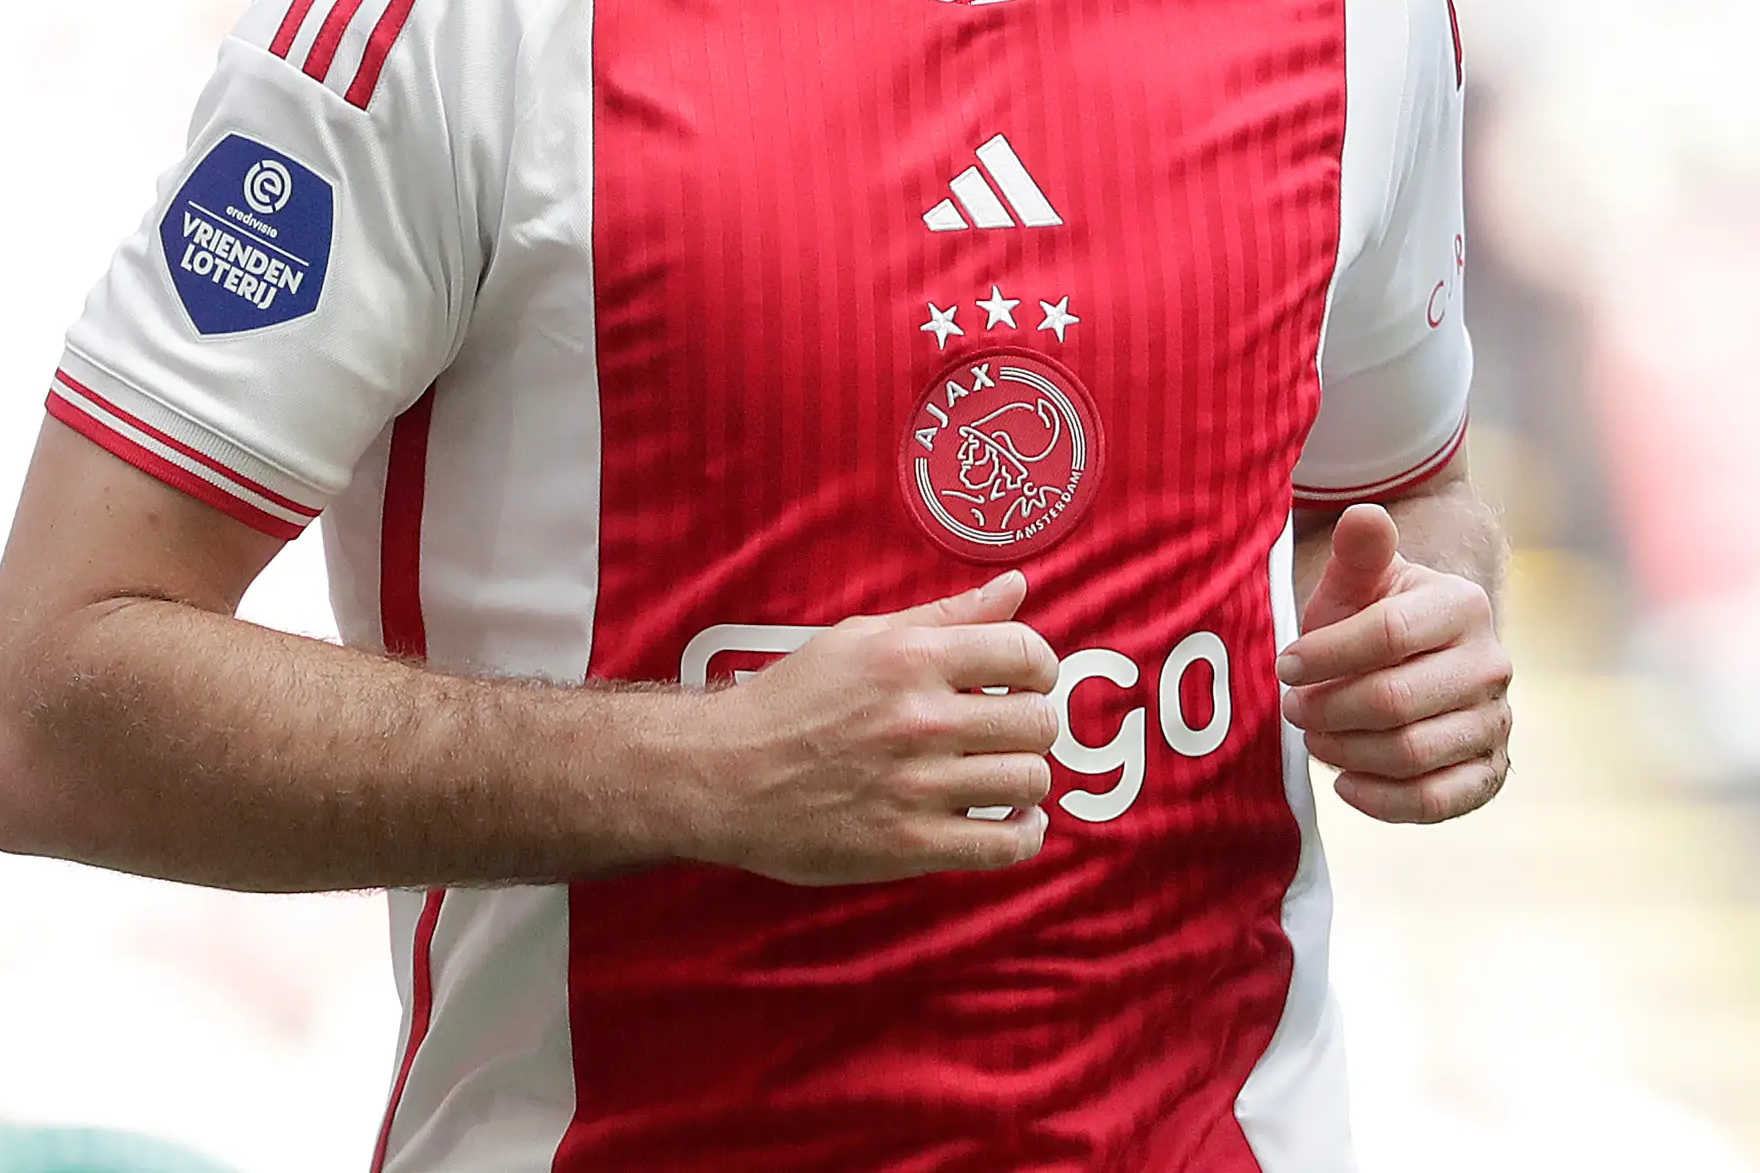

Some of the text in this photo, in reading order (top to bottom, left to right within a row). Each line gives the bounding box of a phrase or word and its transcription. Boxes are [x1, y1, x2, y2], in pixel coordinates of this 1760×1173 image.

[180, 243, 278, 310] LOTERIJ
[182, 210, 304, 295] VRIENDEN
[914, 363, 996, 451] AJAX
[1015, 470, 1083, 541] AMSTERDAM
